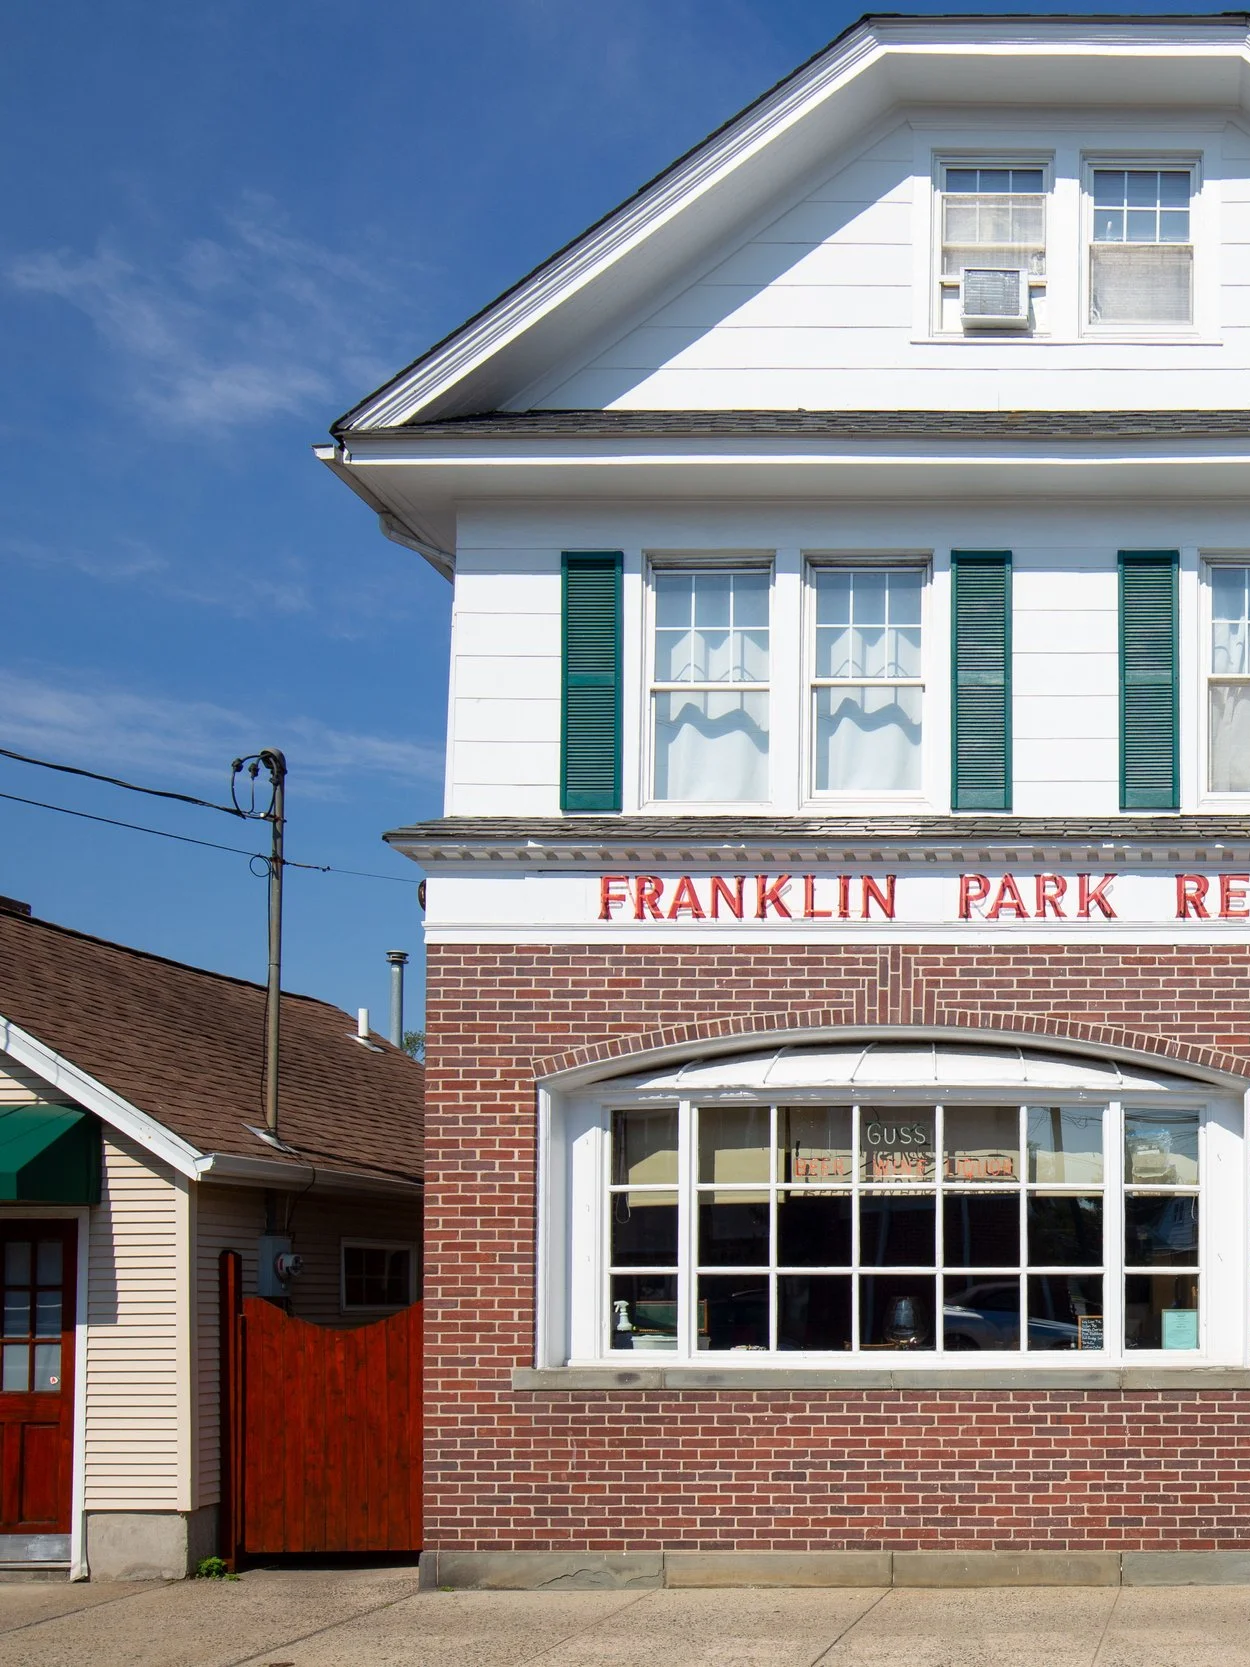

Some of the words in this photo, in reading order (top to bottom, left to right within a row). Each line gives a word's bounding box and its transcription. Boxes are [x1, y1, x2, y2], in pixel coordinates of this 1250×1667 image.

[598, 874, 897, 920] FRANKLIN
[958, 872, 1118, 919] PARK
[796, 1157, 844, 1177] BEER
